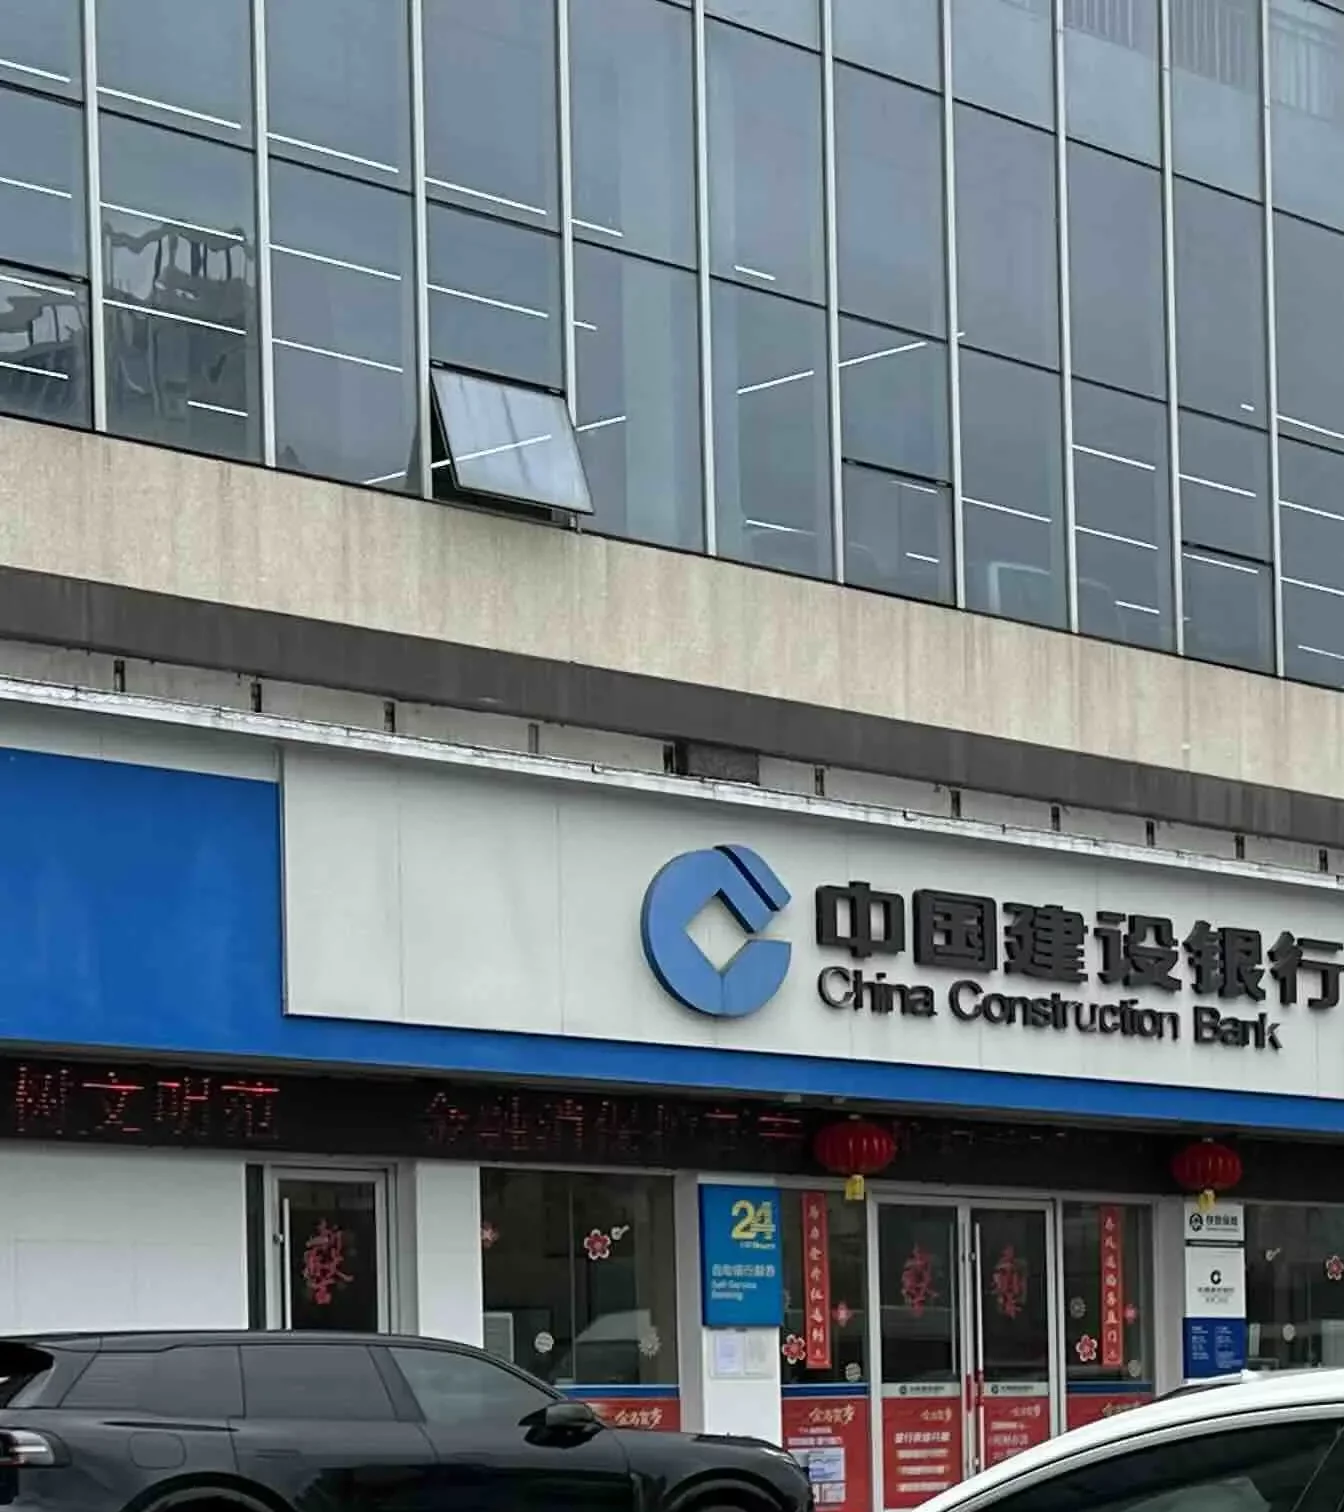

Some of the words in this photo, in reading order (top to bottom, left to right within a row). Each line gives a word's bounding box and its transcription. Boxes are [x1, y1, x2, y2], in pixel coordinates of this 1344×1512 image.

[817, 965, 938, 1017] China
[948, 979, 1179, 1041] Construction
[1193, 1005, 1283, 1050] Bank
[731, 1200, 776, 1240] 24
